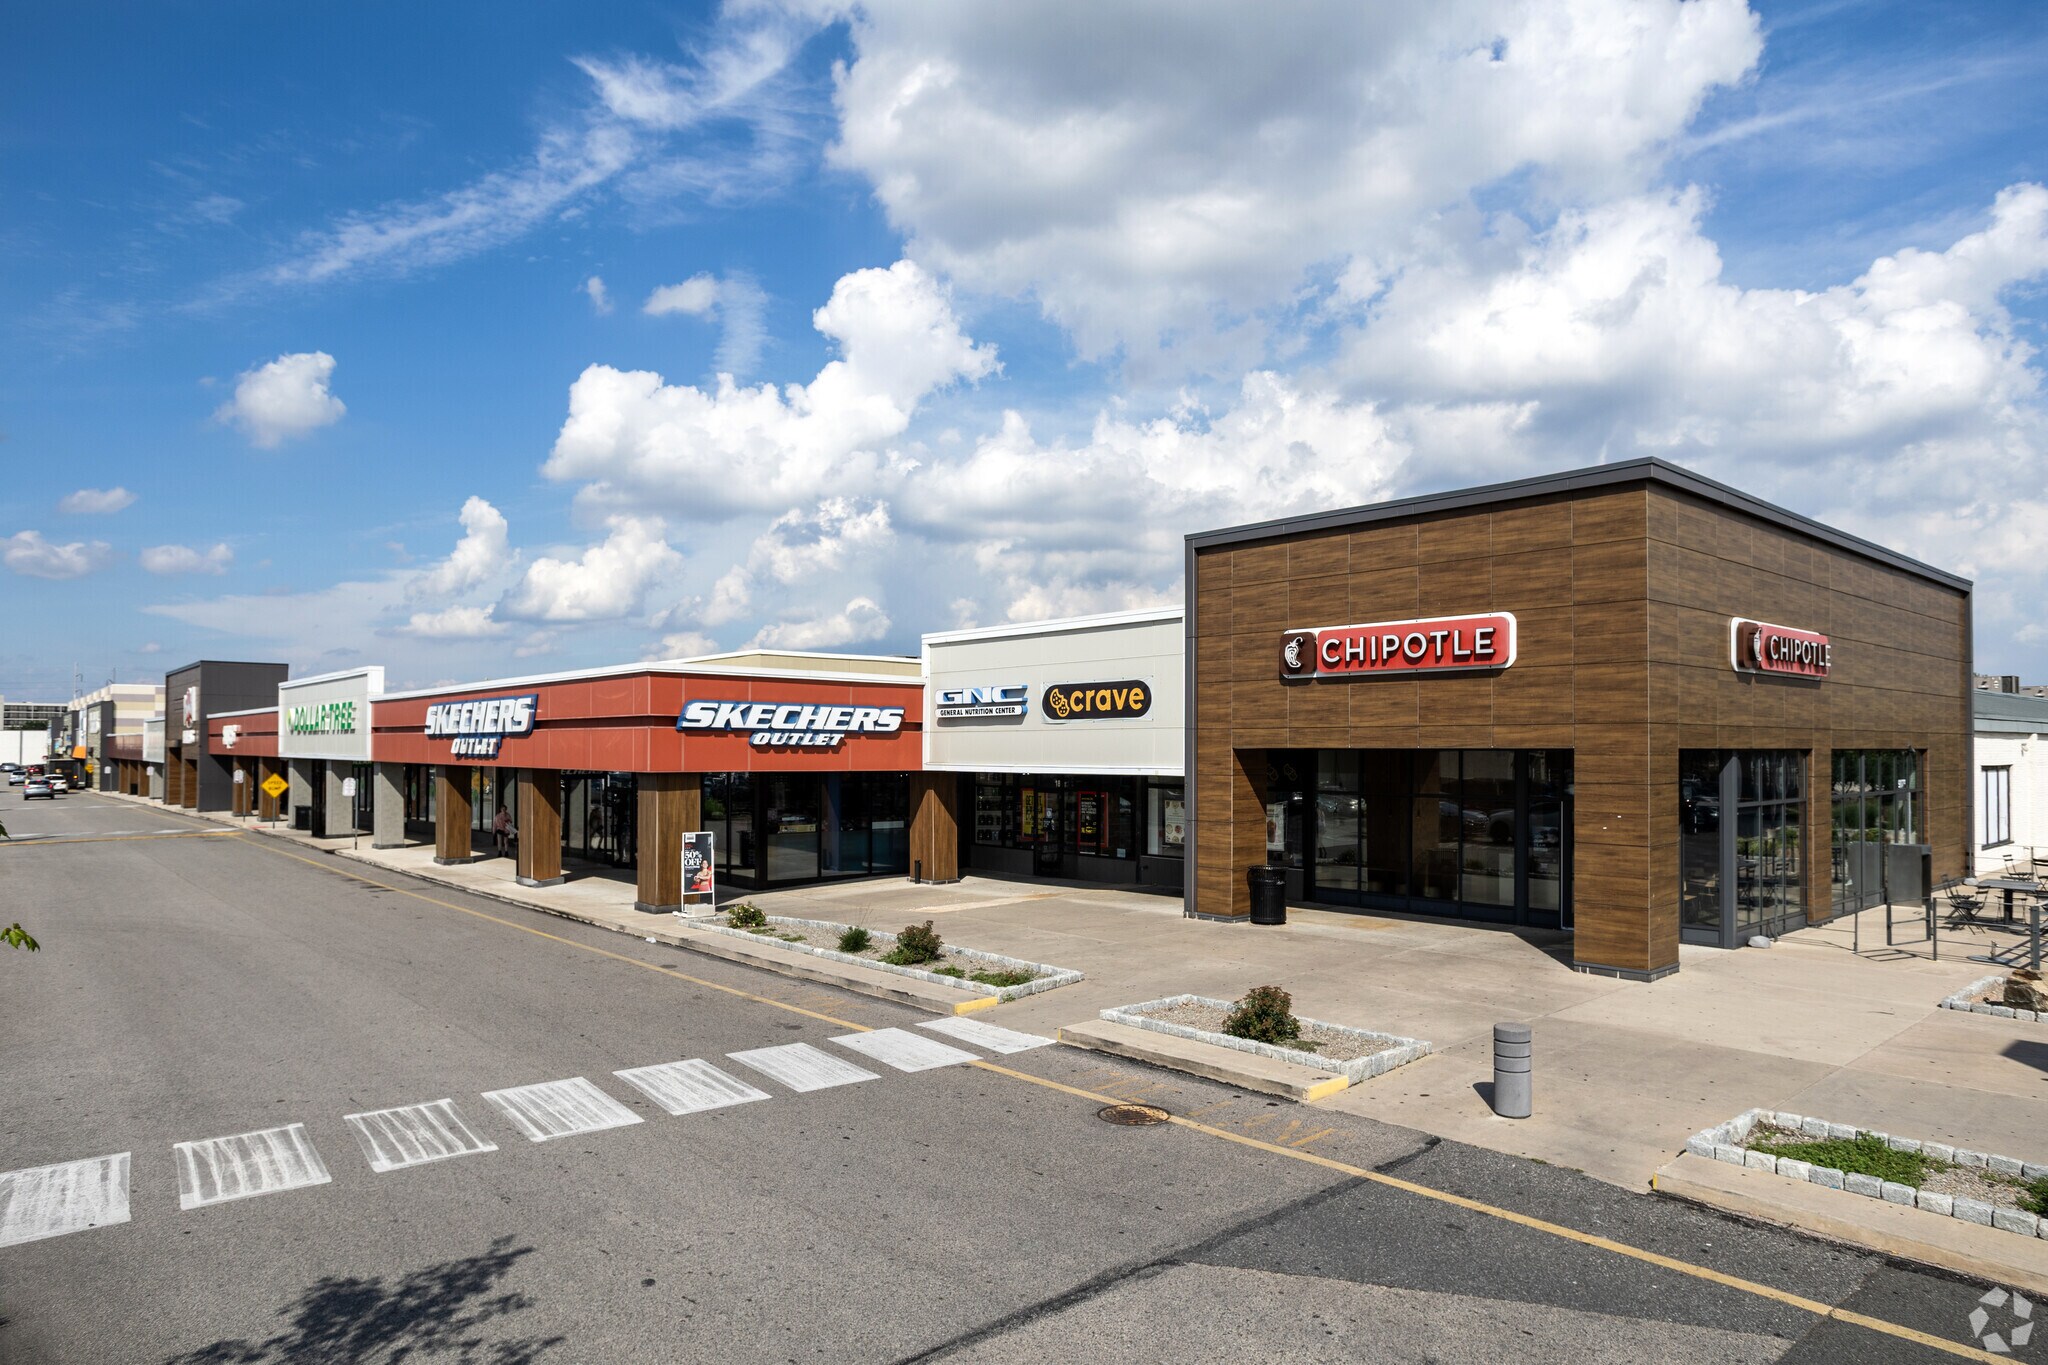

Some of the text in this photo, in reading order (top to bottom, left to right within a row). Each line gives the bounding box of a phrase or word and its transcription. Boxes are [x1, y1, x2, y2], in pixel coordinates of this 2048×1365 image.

[1322, 627, 1496, 663] CHIPOTLE
[1770, 635, 1832, 667] CHIPOTLE
[936, 685, 1027, 705] GNC
[1070, 686, 1145, 713] crave
[294, 701, 353, 731] DOLLAR TREE
[424, 697, 534, 735] SKECHERS
[682, 702, 905, 732] SKECHERS
[940, 707, 1016, 717] GENERAL NUTRITION CENTER
[451, 737, 499, 756] OUTLET
[752, 732, 845, 746] OUTLET
[684, 850, 703, 859] 50%
[684, 858, 702, 866] OFF
